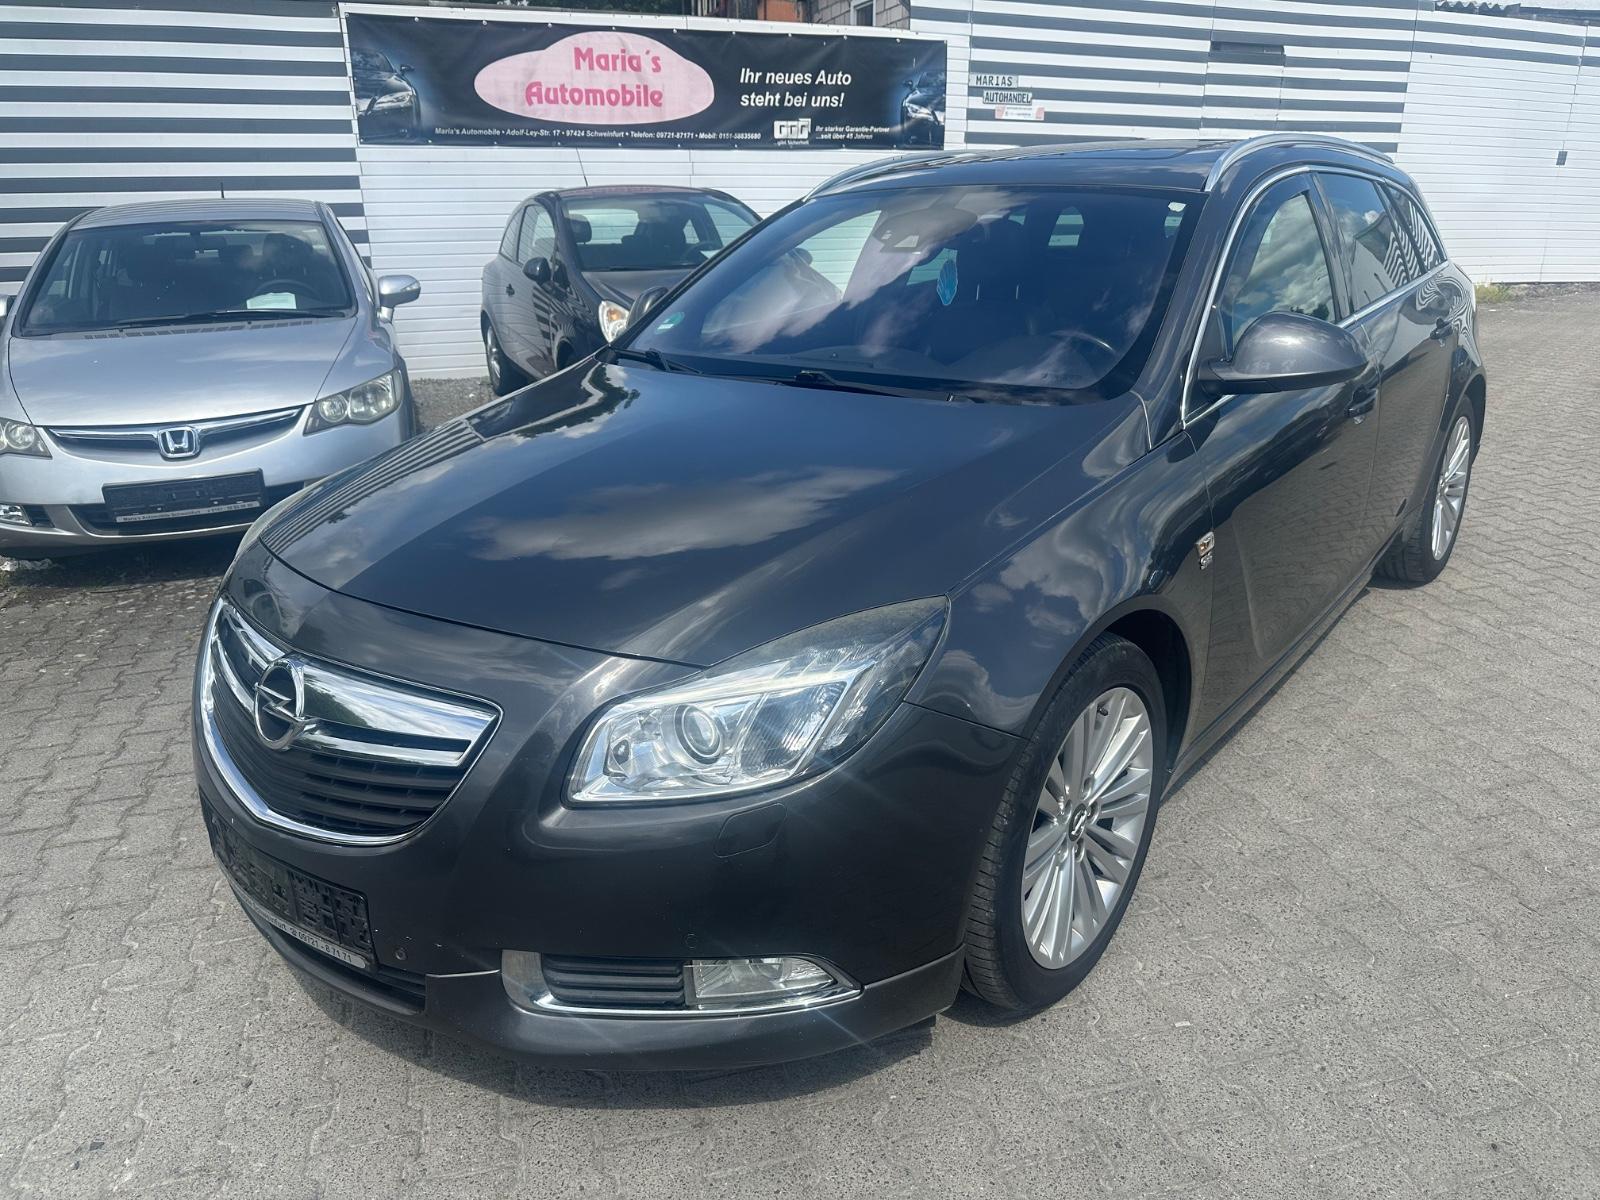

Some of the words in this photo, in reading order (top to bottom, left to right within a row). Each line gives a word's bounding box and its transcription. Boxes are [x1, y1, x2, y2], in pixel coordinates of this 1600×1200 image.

[740, 67, 762, 84] Ihr
[765, 72, 812, 85] neues
[815, 69, 852, 85] Auto
[975, 75, 1013, 87] MARIAS
[525, 81, 664, 107] Automobile
[740, 91, 781, 107] steht
[784, 91, 807, 107] bei
[811, 92, 845, 107] uns!
[984, 91, 1031, 104] AUTOHANDEL
[461, 128, 500, 136] Automobile
[506, 128, 550, 138] Adolf-Ley-Str.
[553, 129, 560, 137] 17
[565, 130, 585, 138] 97424
[586, 130, 625, 138] Schweinfurt
